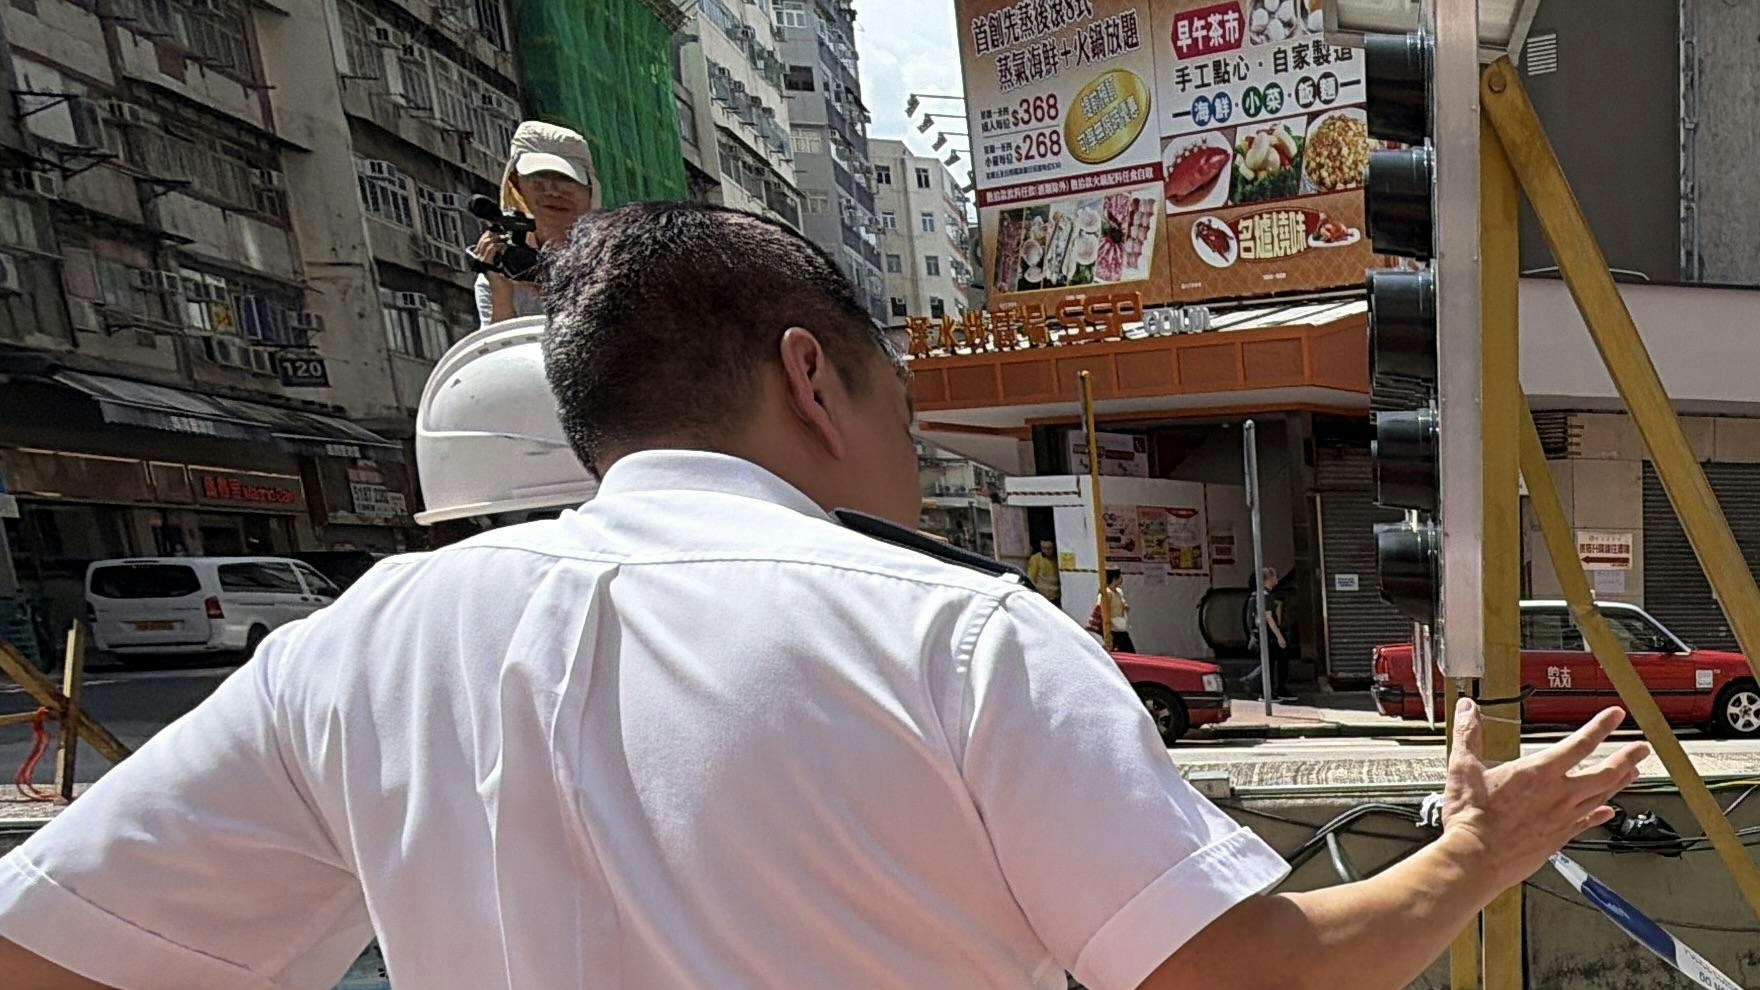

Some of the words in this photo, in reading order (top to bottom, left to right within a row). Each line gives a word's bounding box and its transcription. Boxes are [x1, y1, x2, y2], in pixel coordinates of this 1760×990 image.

[1176, 10, 1240, 53] 早午茶市
[1011, 93, 1059, 127] $368
[1014, 130, 1062, 163] $268
[282, 361, 322, 377] 120
[1547, 667, 1571, 678] 的士
[1550, 677, 1571, 688] TAXI
